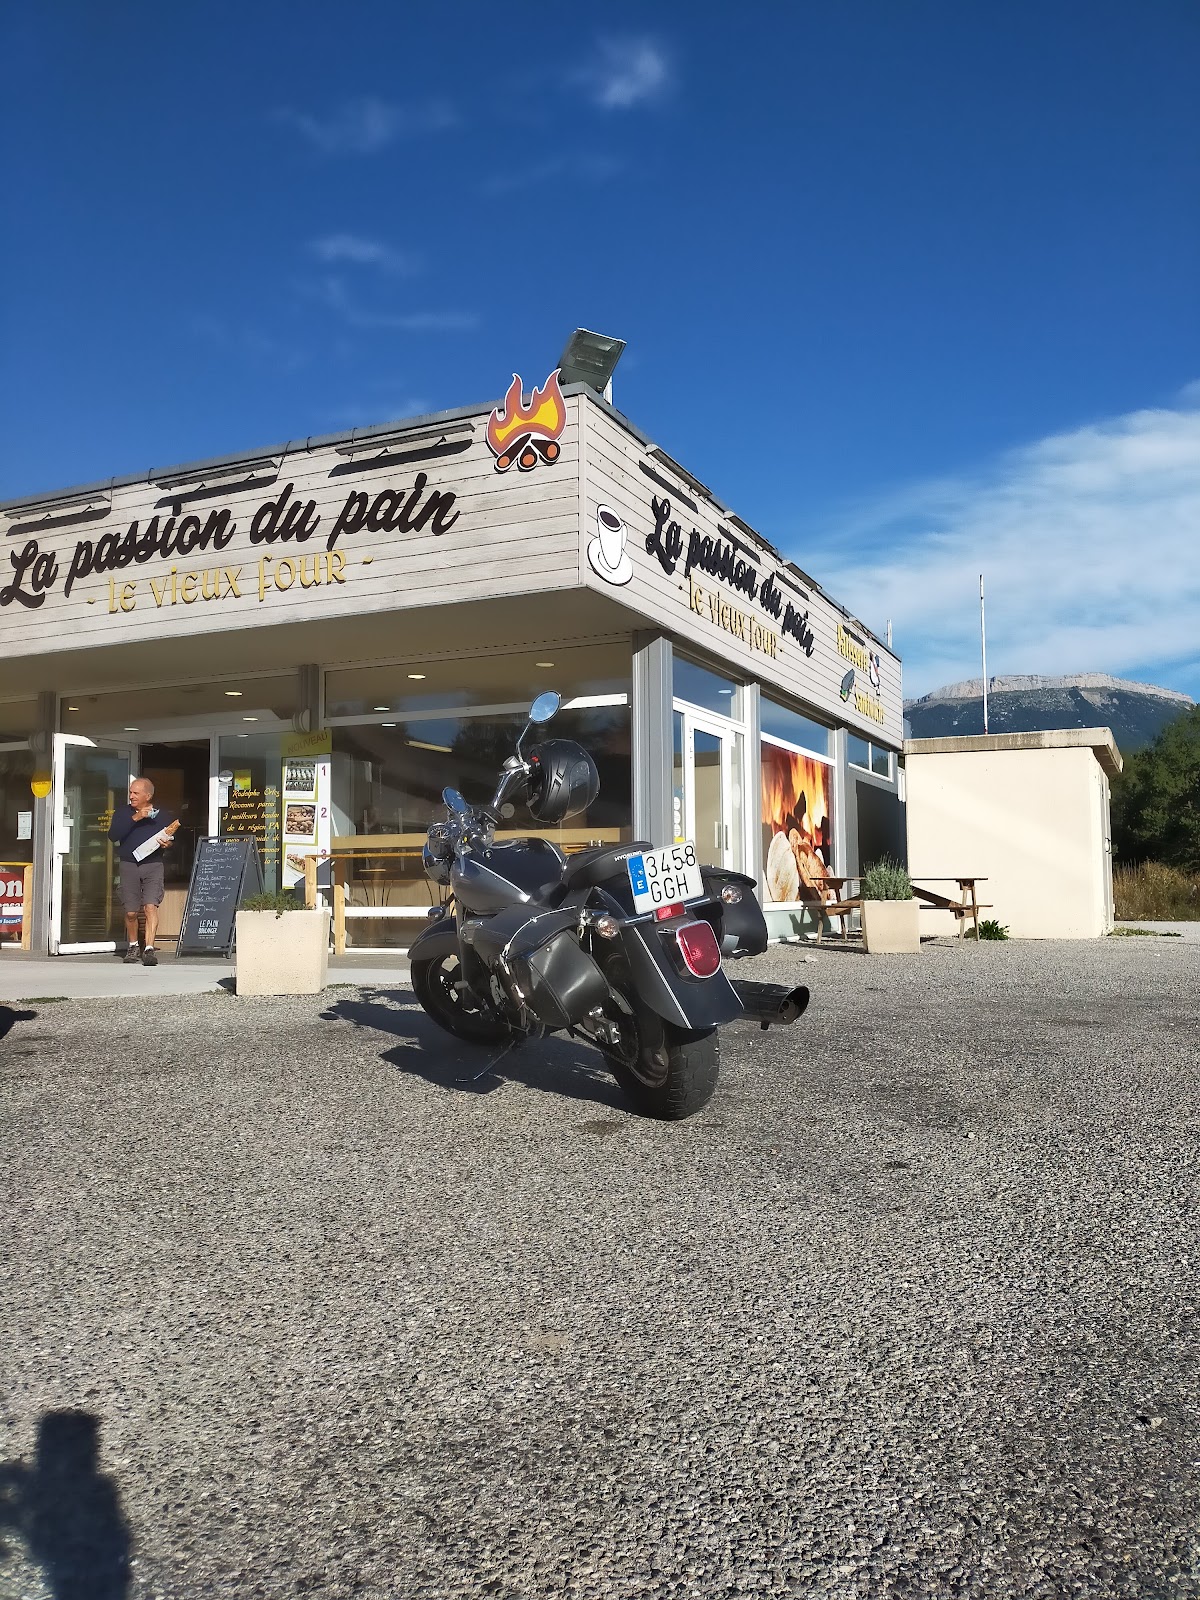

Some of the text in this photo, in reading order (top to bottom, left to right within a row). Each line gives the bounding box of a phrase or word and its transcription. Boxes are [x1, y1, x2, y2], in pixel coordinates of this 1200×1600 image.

[0, 472, 460, 608] La passion du pain
[108, 576, 136, 613] le
[150, 565, 242, 608] vieux
[646, 495, 814, 657] La passion du pain
[688, 572, 704, 615] le
[707, 591, 745, 642] vieux
[287, 731, 329, 754] NOUVEAU
[321, 765, 327, 777] 1
[320, 807, 328, 818] 2
[646, 845, 696, 878] 3458
[637, 880, 645, 889] E
[650, 873, 689, 903] GGH
[199, 920, 206, 928] LE
